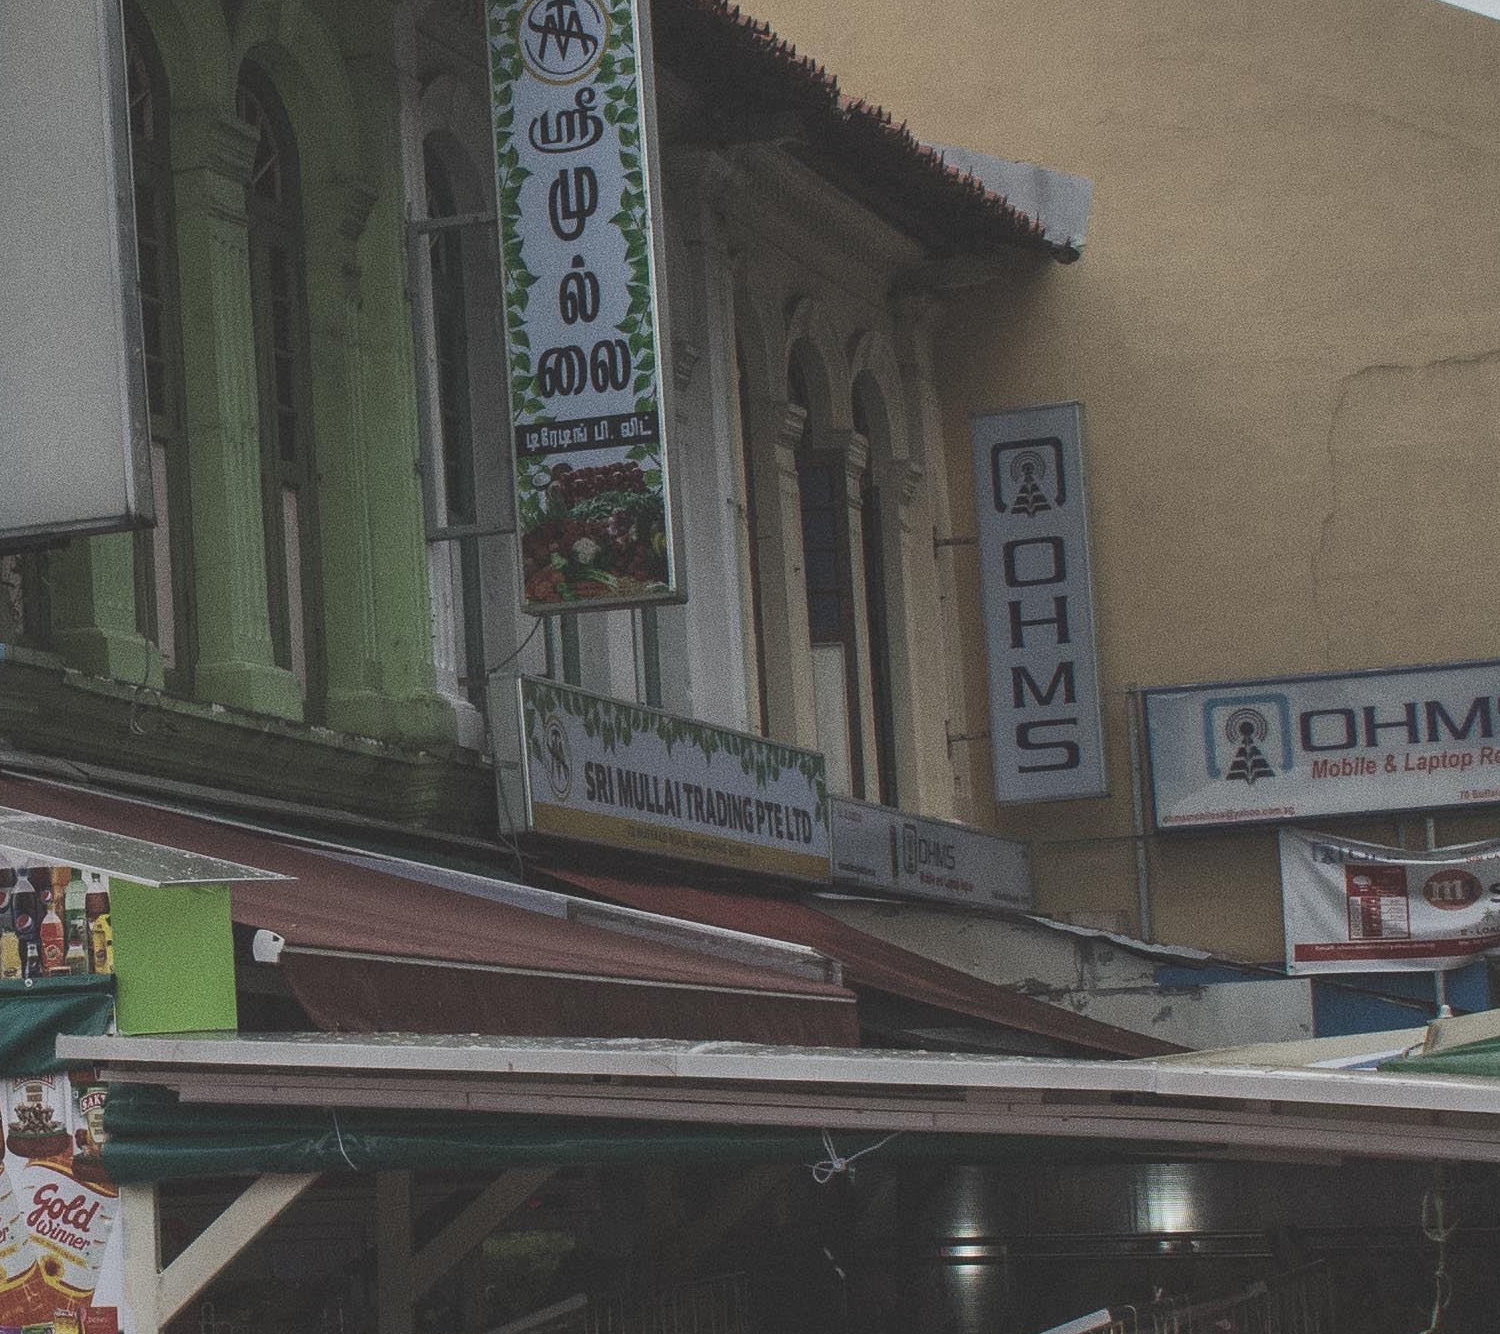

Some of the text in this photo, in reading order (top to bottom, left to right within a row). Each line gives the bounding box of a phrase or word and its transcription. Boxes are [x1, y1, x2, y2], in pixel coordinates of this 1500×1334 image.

[1003, 535, 1081, 773] OHMS
[1311, 755, 1378, 780] Mobile
[1385, 755, 1397, 772] &
[1404, 748, 1473, 775] Laptop
[584, 762, 614, 805] SRI
[618, 768, 681, 818] MULLAI
[683, 782, 754, 834] TRADING
[755, 798, 784, 840] PTE
[784, 804, 812, 845] LTD
[26, 1183, 100, 1233] Gold
[36, 1219, 91, 1251] winner
